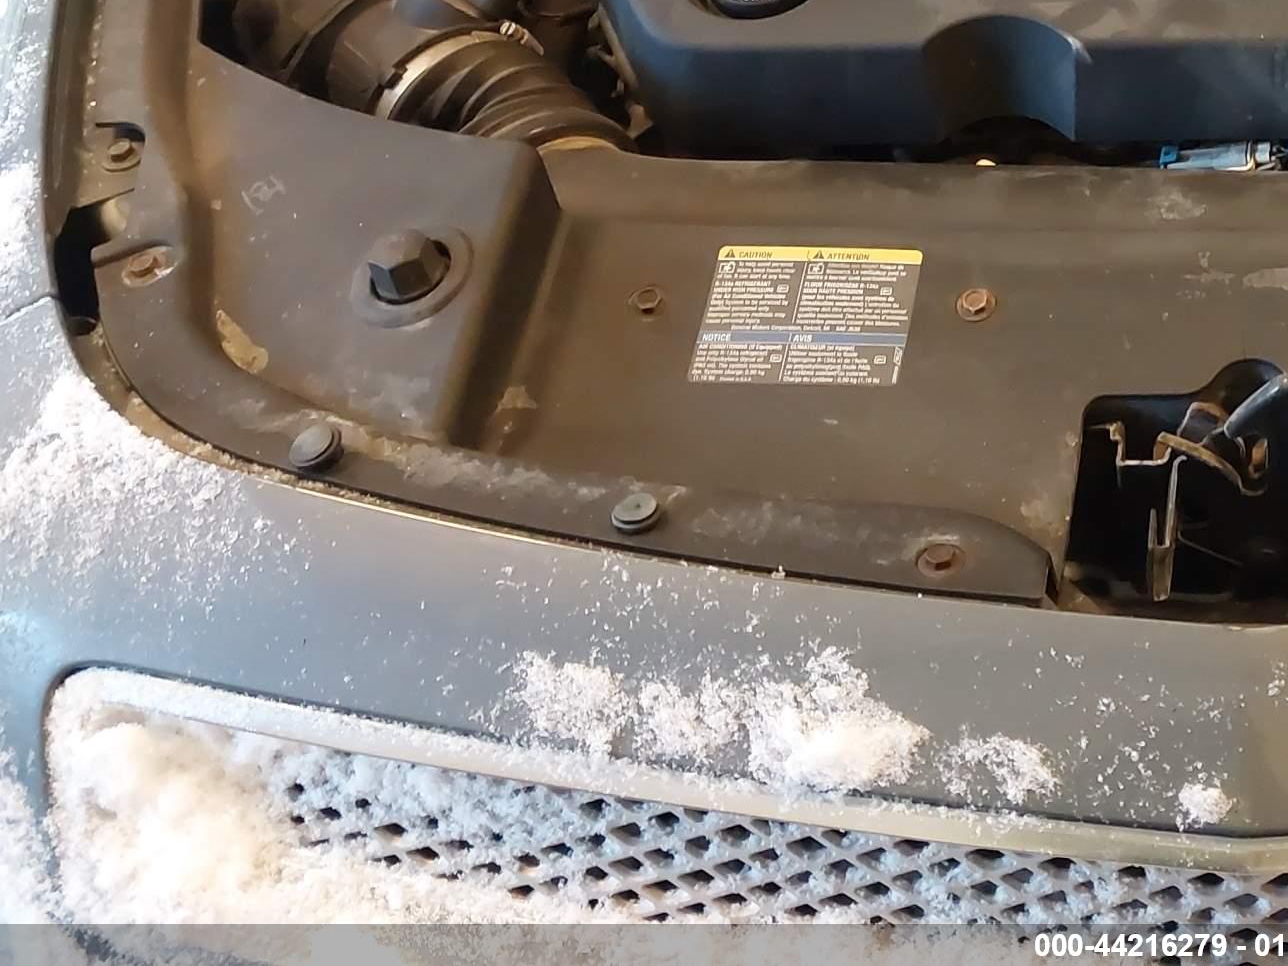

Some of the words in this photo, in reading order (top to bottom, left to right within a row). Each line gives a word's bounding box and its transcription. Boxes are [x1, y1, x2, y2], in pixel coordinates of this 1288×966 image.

[738, 251, 773, 259] CAUTION
[827, 253, 870, 261] ATTENTION
[702, 333, 732, 341] NOTICE
[792, 334, 813, 342] AVIS
